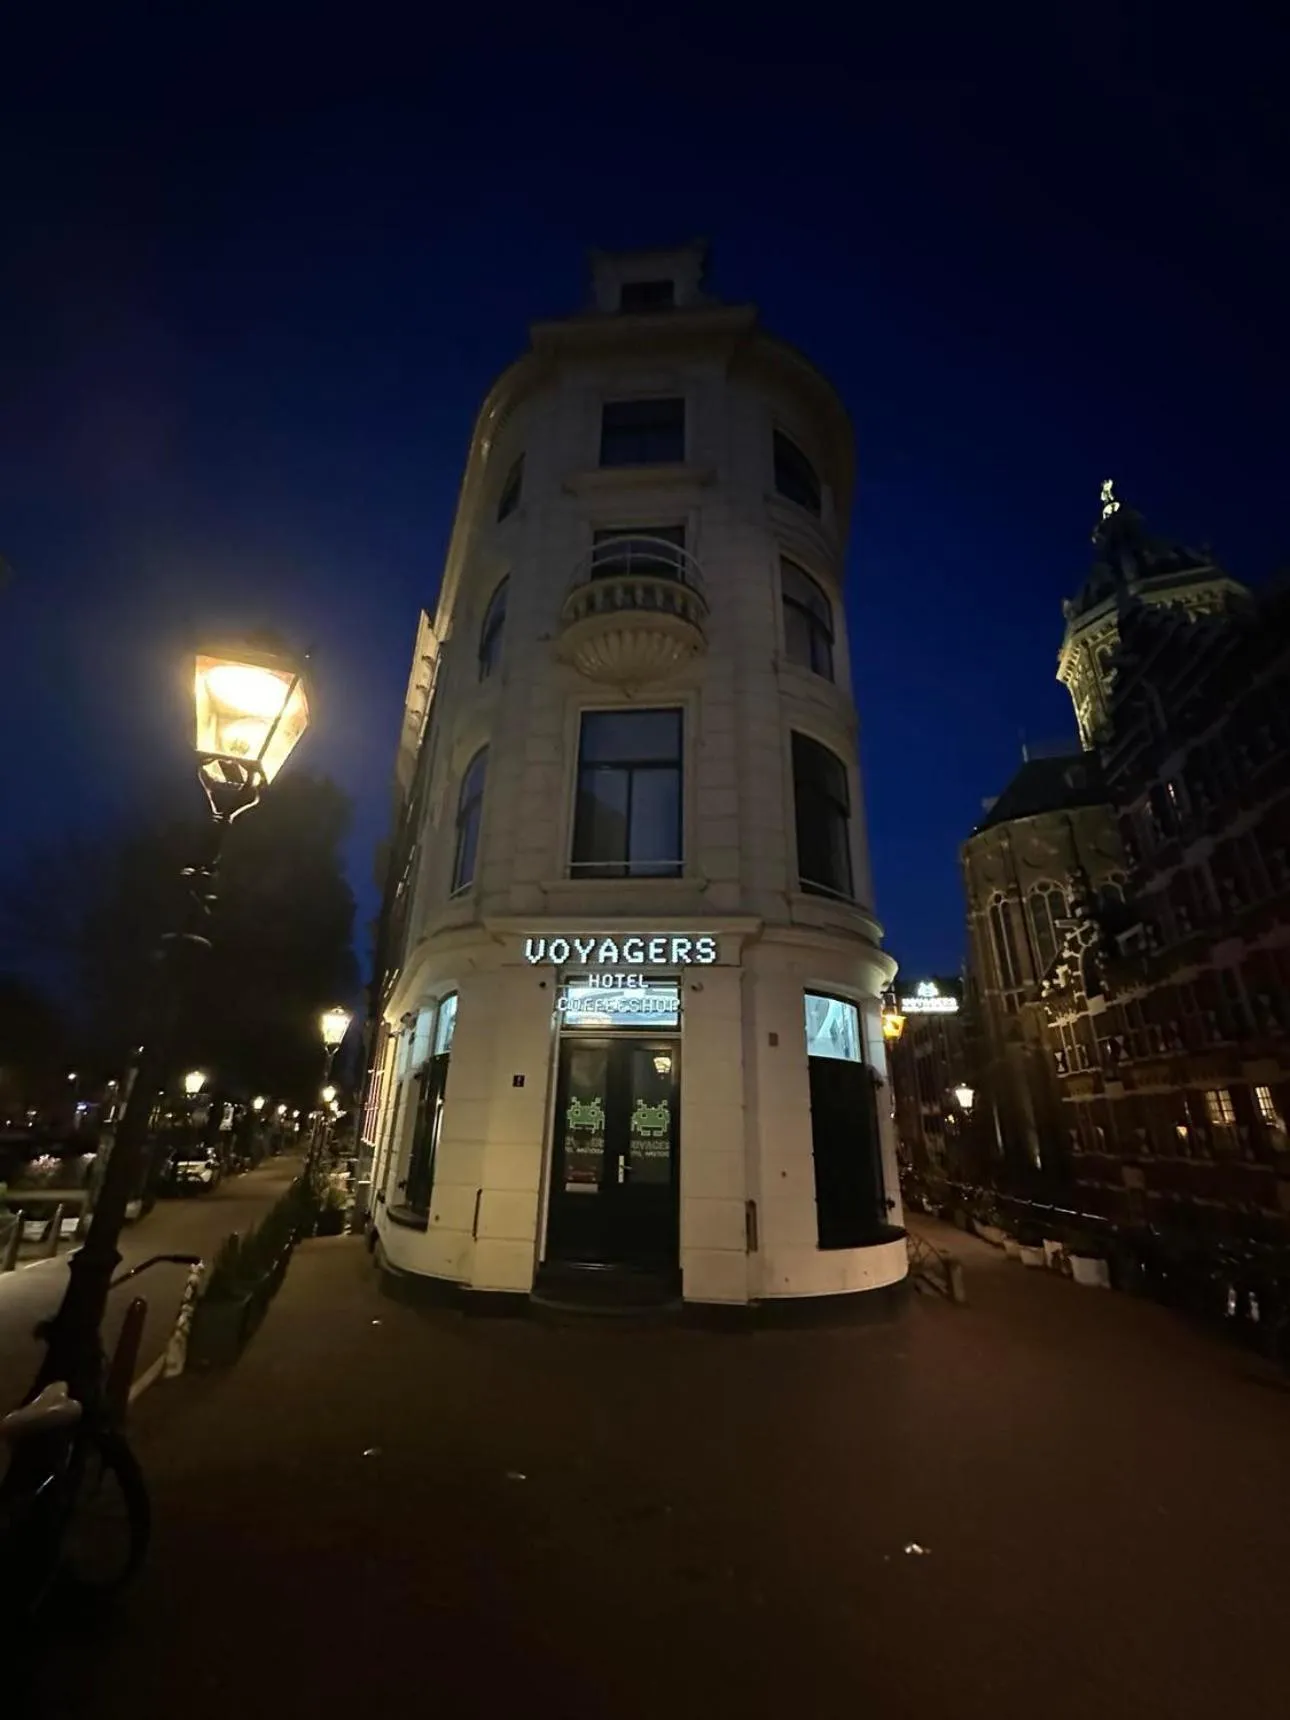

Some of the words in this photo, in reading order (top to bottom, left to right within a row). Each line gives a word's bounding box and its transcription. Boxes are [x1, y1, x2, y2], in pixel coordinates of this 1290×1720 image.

[525, 938, 716, 963] VOYAGERS
[588, 974, 649, 988] HOTEL
[558, 997, 680, 1013] COFFEESHOP
